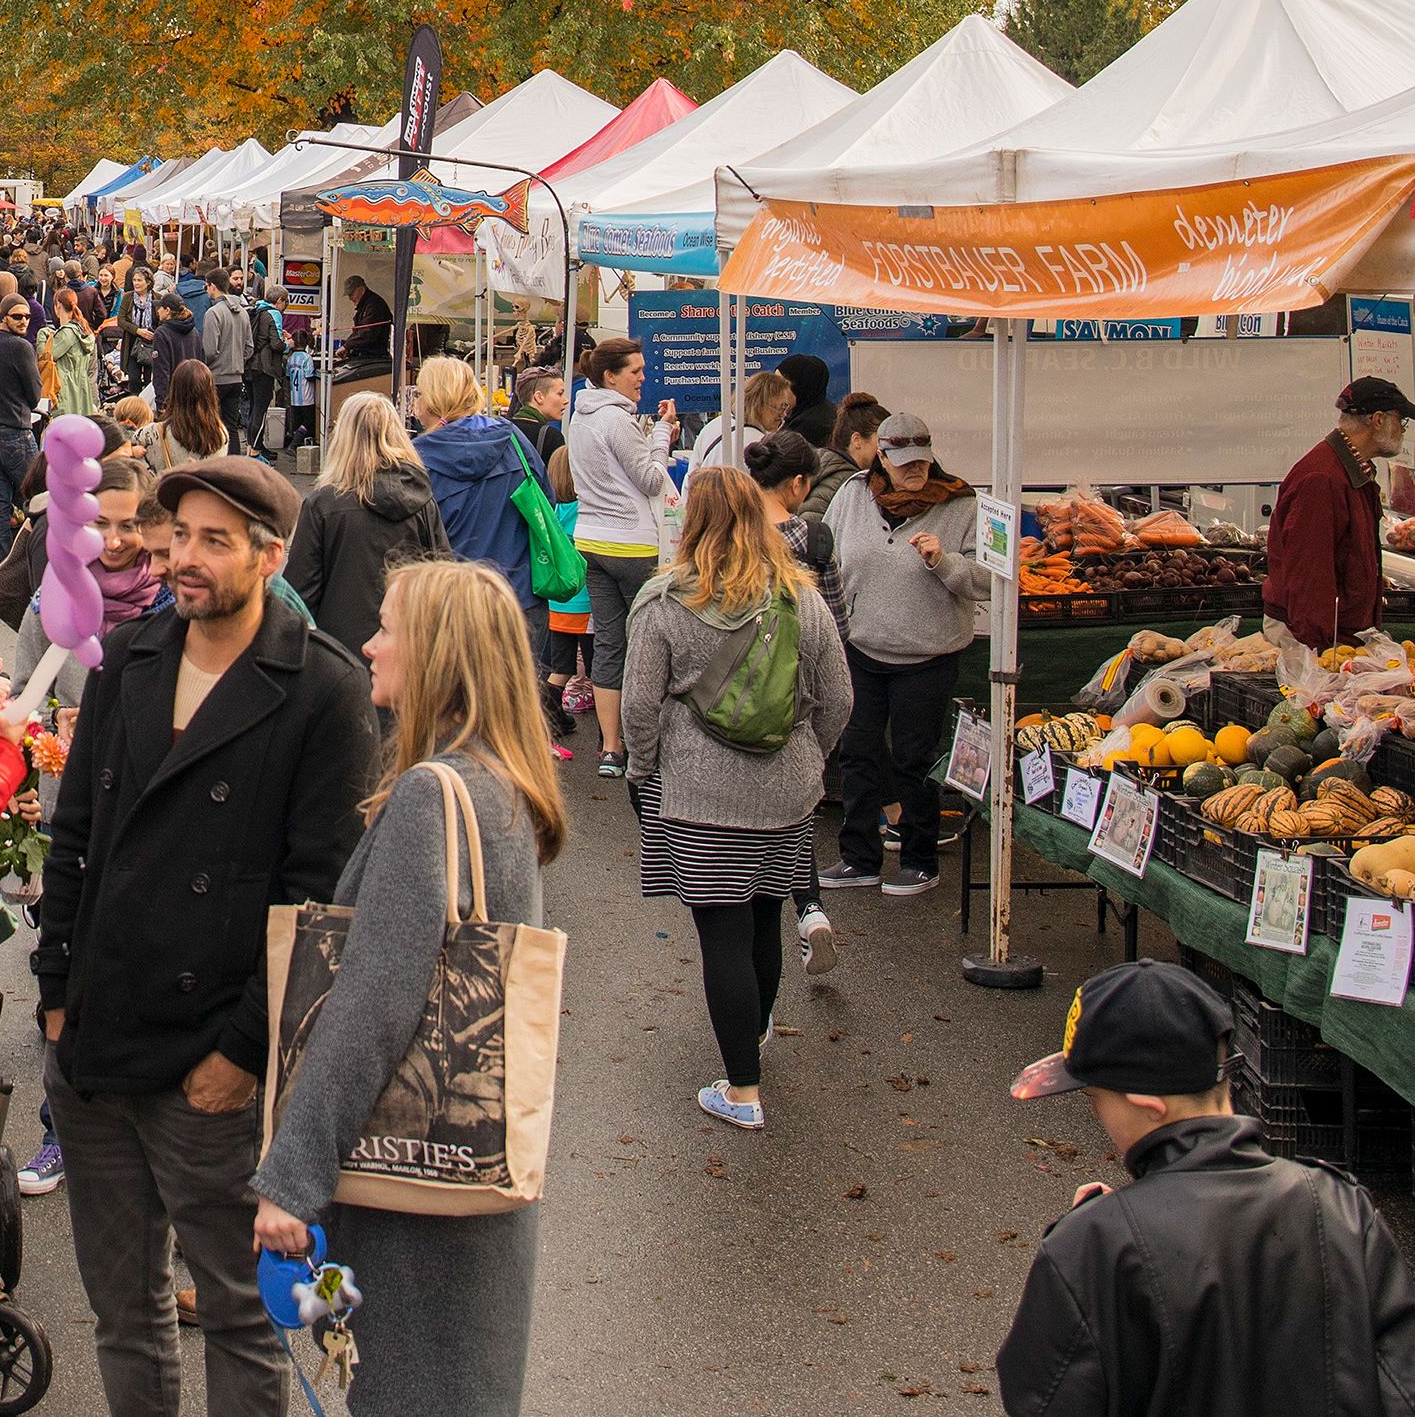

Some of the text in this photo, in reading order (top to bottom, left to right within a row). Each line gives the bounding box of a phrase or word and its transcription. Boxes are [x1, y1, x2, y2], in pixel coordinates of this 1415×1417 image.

[761, 210, 822, 252] organic
[1173, 200, 1295, 251] demeter
[633, 225, 677, 259] Seafoods
[682, 232, 701, 247] Ocean
[862, 239, 1149, 294] FORSTBAUER FARM
[285, 269, 320, 278] MasterCard
[288, 294, 315, 305] VISA
[639, 309, 668, 319] Become
[680, 305, 715, 319] Share
[752, 304, 784, 317] Catch
[789, 308, 821, 316] Member
[834, 305, 862, 317] Blue
[842, 317, 899, 330] Seafoods
[653, 333, 659, 342] A
[660, 333, 705, 343] Community
[664, 349, 694, 358] Support
[755, 347, 788, 355] Business
[664, 363, 694, 371] Receive
[664, 377, 699, 386] Purchase
[684, 394, 711, 402] Ocean
[981, 501, 1012, 521] Accepted Here
